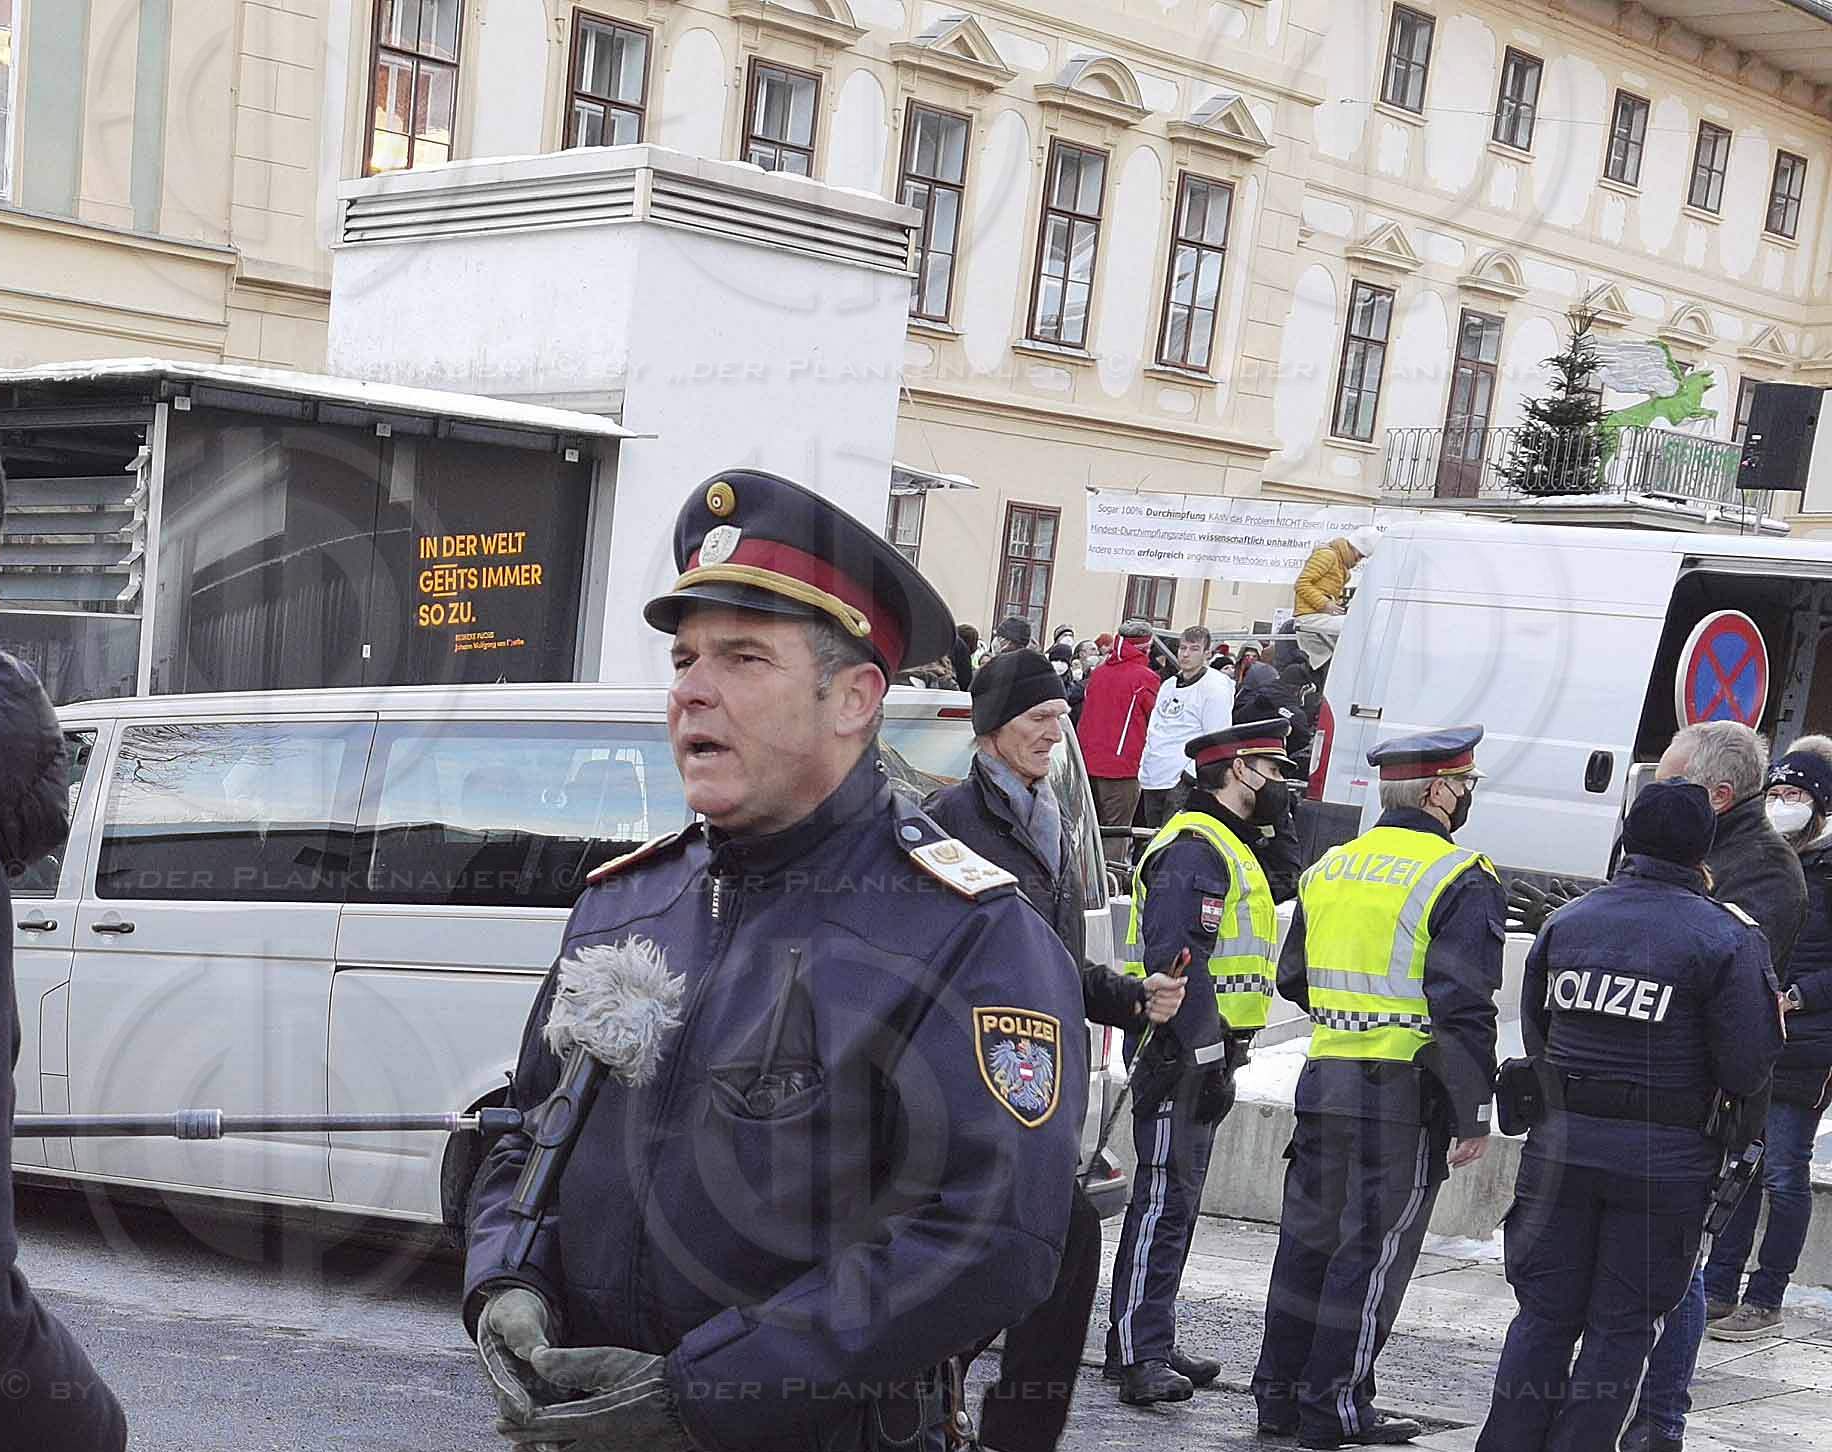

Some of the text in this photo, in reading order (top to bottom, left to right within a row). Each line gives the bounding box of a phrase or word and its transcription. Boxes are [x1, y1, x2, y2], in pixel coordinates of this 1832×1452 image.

[1145, 507, 1206, 521] Durchimpfung
[419, 531, 526, 559] IN DER WELT
[1137, 548, 1184, 561] erfolgreich
[419, 564, 542, 593] GEHTS IMMER
[418, 601, 477, 627] SO ZU.
[1312, 852, 1423, 886] POLIZEI
[1544, 970, 1673, 1022] POLIZEI
